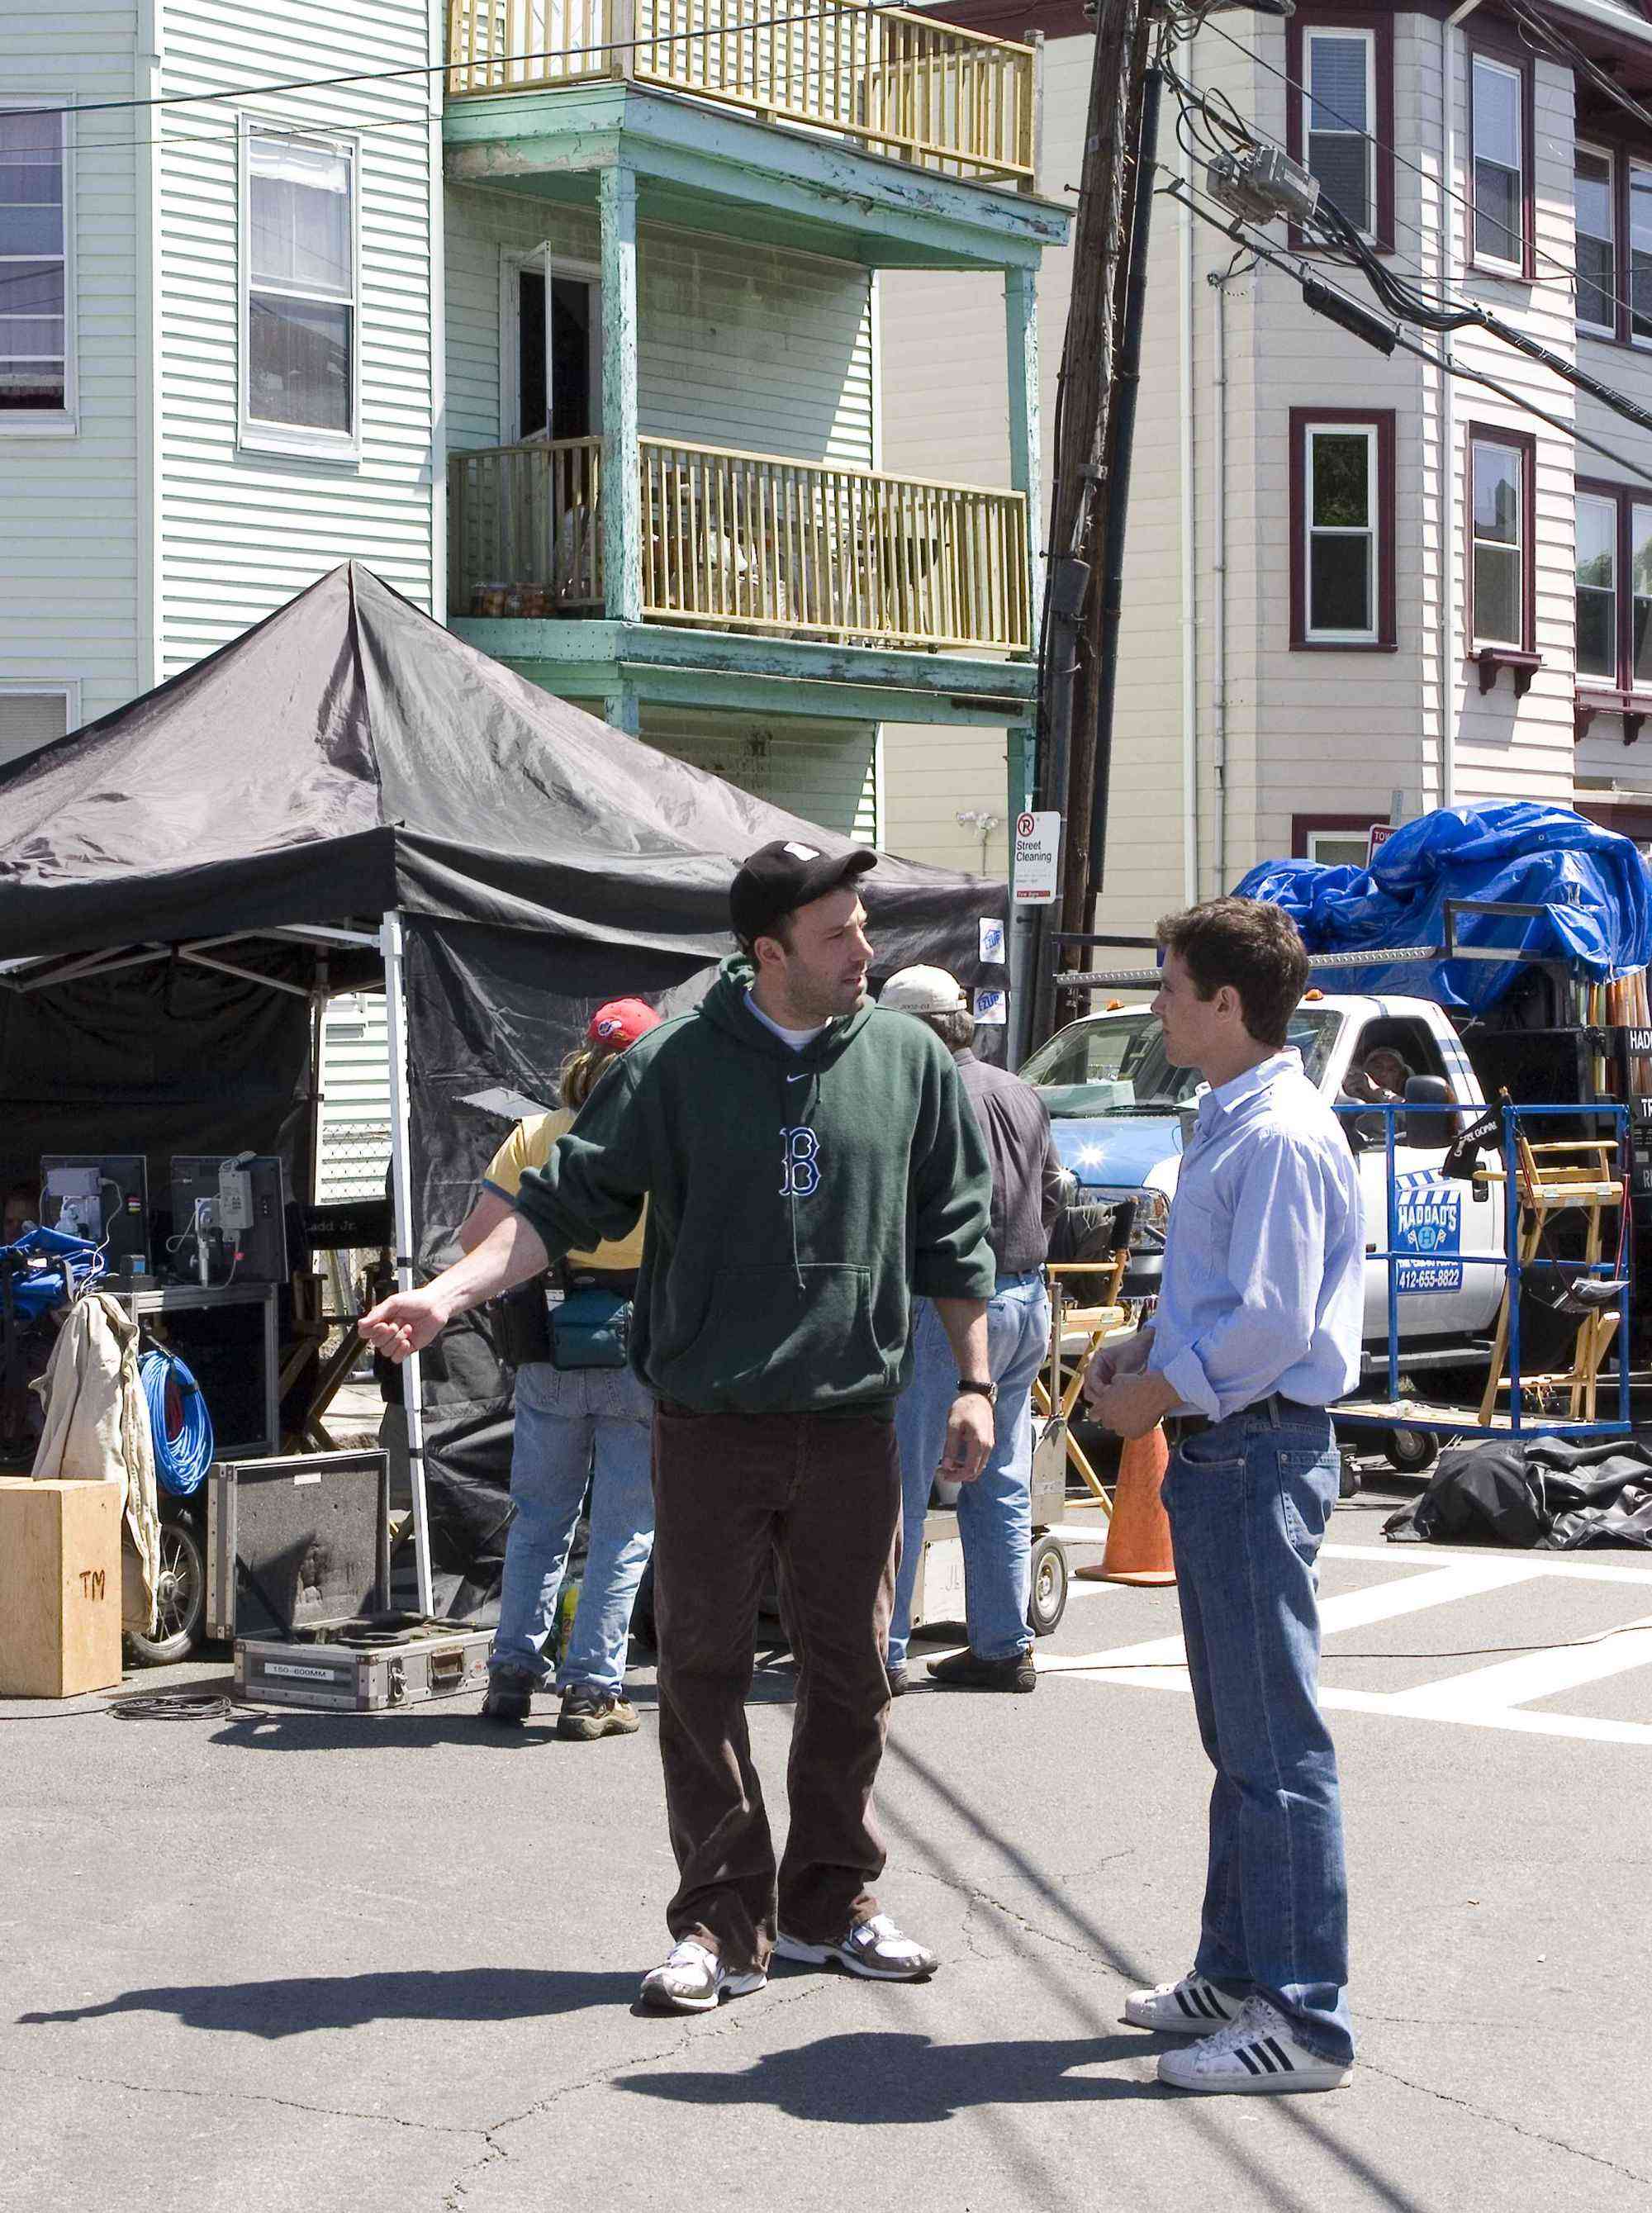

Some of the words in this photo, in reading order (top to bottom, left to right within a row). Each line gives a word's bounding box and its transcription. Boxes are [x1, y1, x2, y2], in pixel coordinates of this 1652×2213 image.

[1017, 840, 1041, 851] Street
[1016, 852, 1051, 863] Cleaning
[1630, 1030, 1652, 1050] HAD
[779, 1127, 821, 1196] B
[1643, 1169, 1652, 1188] R
[1398, 1205, 1457, 1235] HADDAD'S
[1398, 1269, 1460, 1289] 412-655-8822
[79, 1570, 105, 1601] TM
